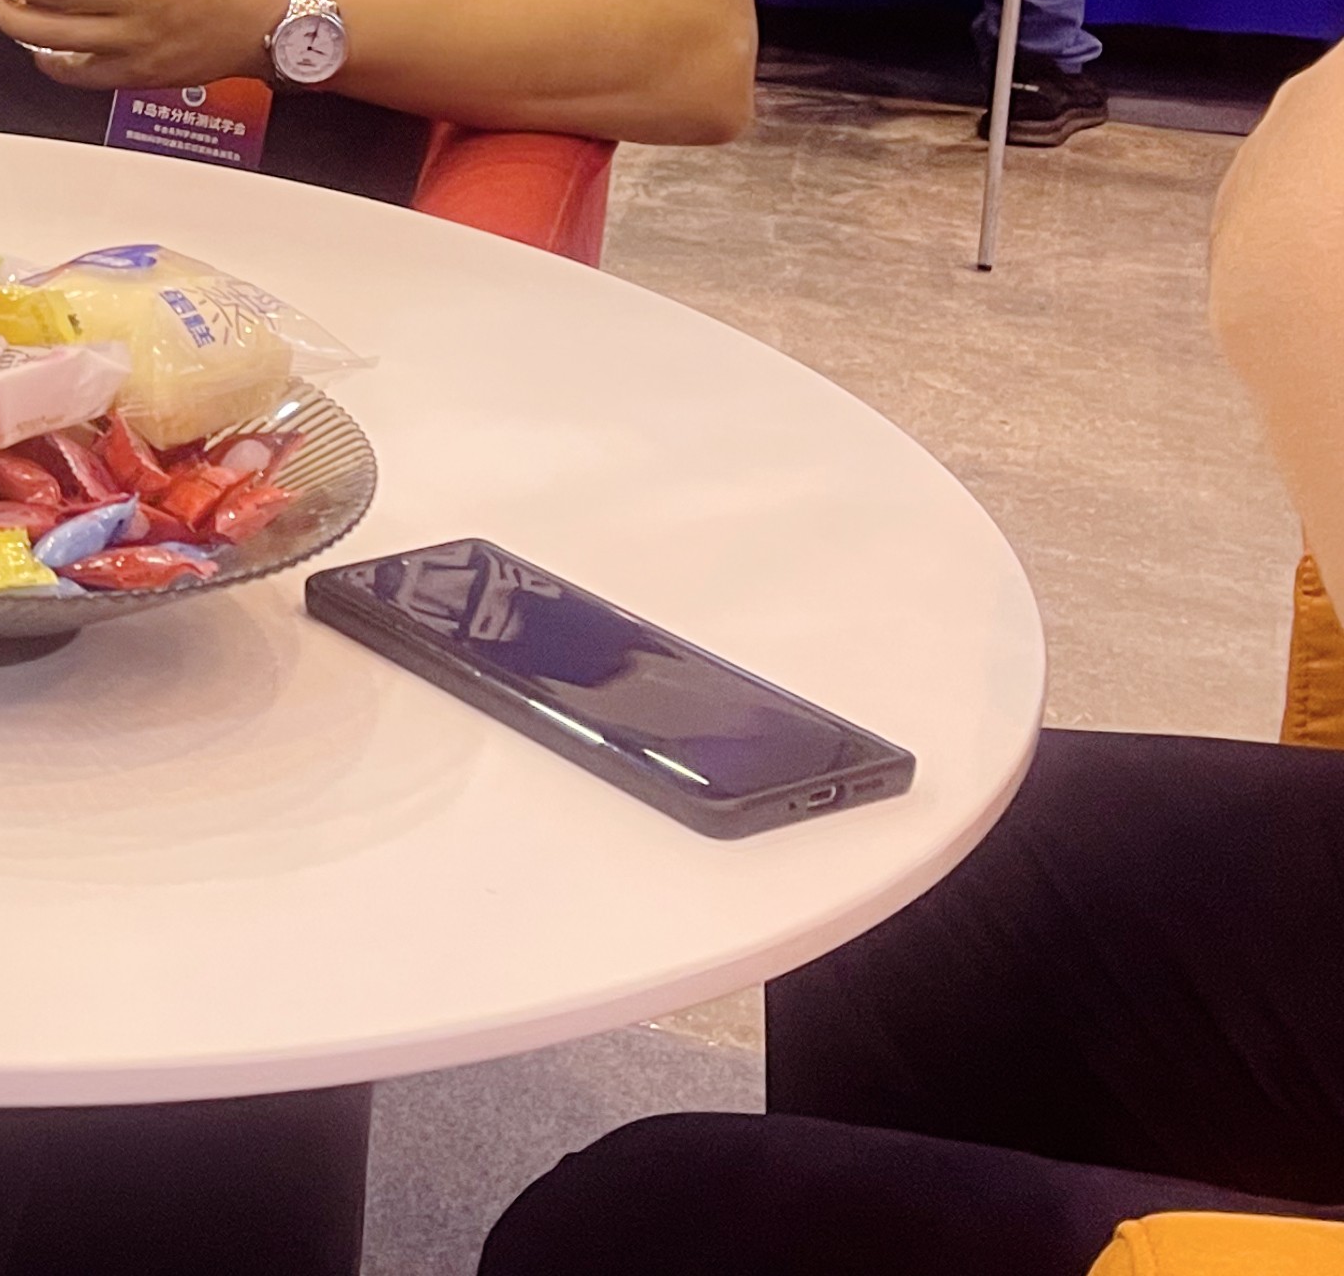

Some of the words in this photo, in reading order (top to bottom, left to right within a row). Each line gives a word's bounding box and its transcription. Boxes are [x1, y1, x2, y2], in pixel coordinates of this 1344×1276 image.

[131, 100, 246, 136] 青岛市分析测试学会
